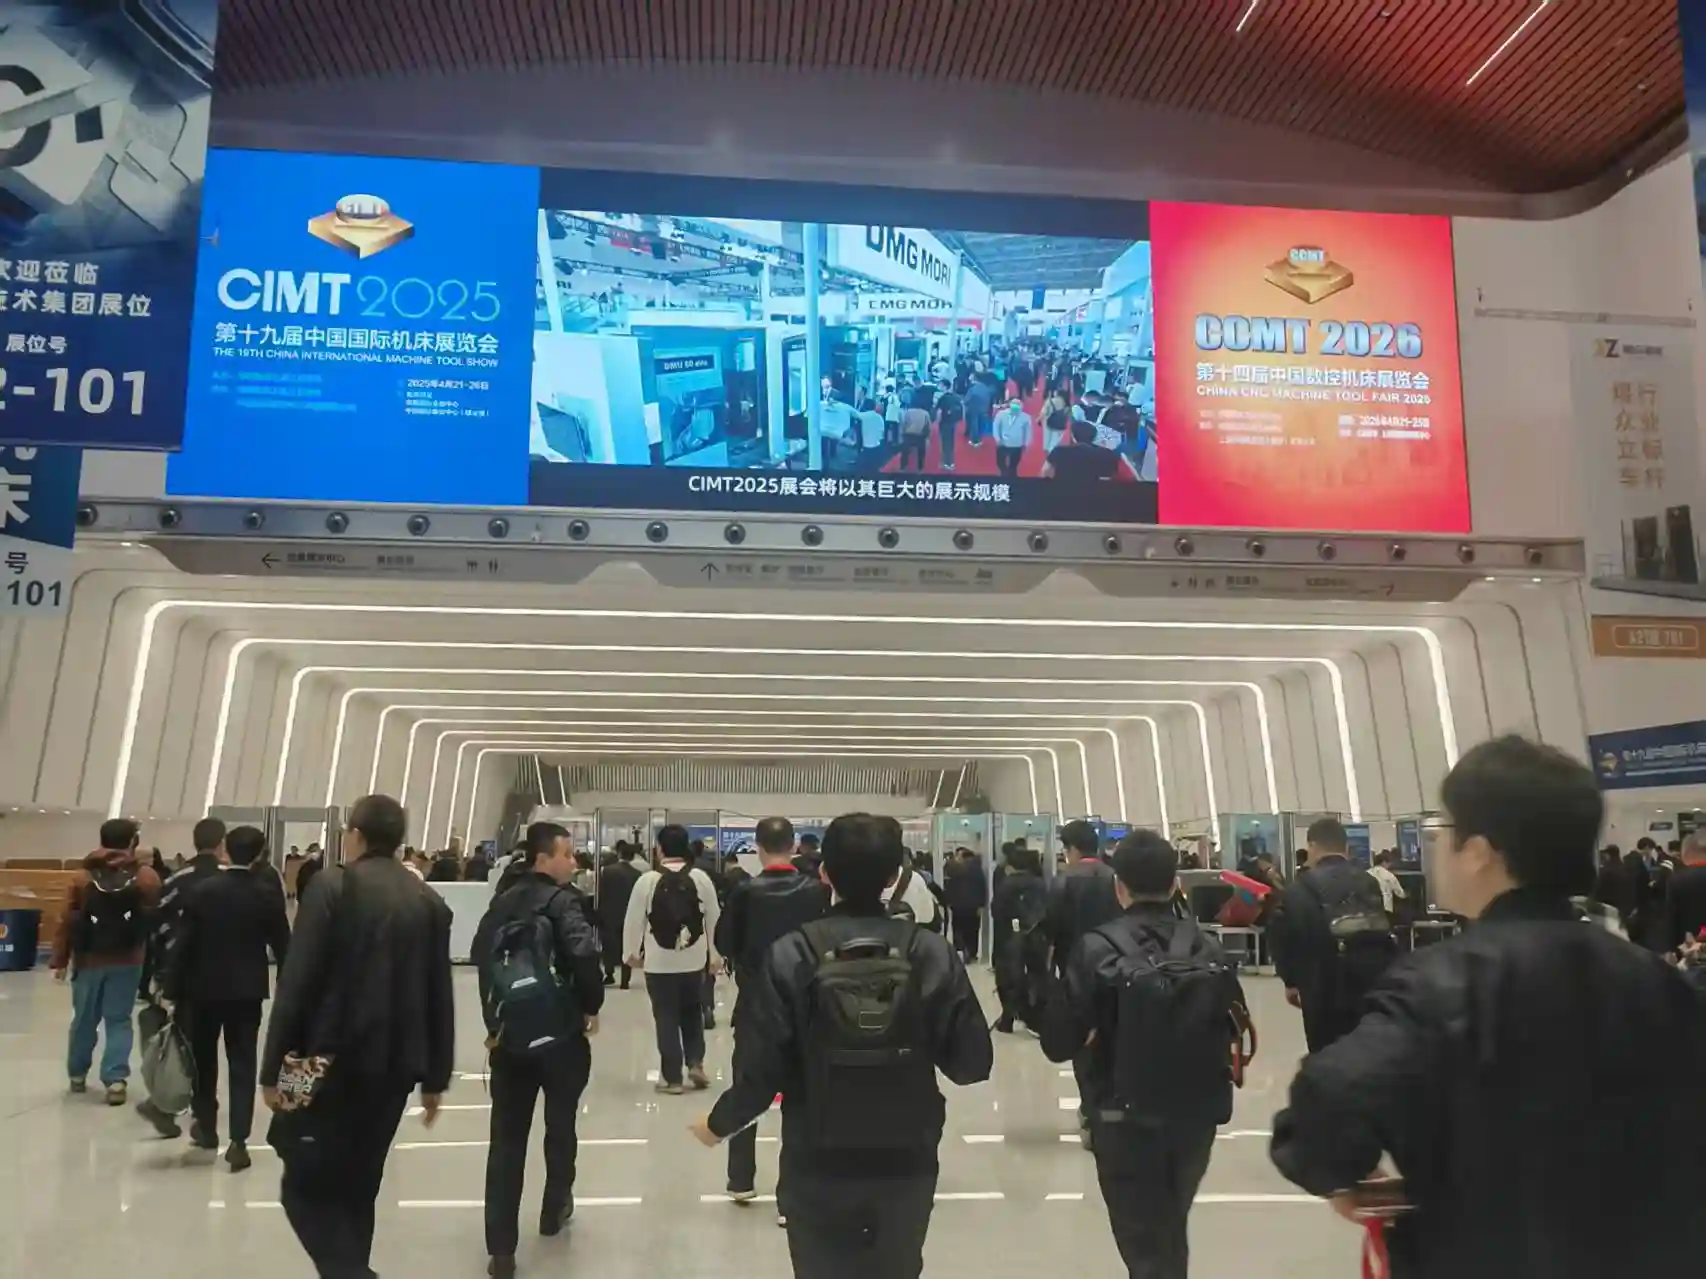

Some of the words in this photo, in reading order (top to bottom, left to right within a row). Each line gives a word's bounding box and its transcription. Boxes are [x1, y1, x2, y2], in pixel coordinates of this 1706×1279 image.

[920, 248, 952, 289] MORI
[0, 289, 152, 317] 术集团展位
[217, 268, 351, 316] CIMT
[356, 275, 502, 322] 2025
[6, 334, 67, 355] 展位号
[214, 321, 500, 355] 第十九届中国国际机床展览会
[1194, 313, 1311, 354] CCMT
[1318, 320, 1423, 358] 2026
[214, 347, 235, 358] THE
[238, 348, 264, 359] 19TH
[266, 349, 299, 360] CHINA
[302, 351, 383, 363] INTERNATIONAL
[386, 354, 433, 365] MACHINE
[437, 356, 464, 366] TOOL
[467, 357, 499, 368] SHOW
[1195, 361, 1430, 390] 第十四届中国数控机床展览会
[0, 366, 146, 417] -101
[1196, 384, 1240, 397] CHINA
[1241, 386, 1270, 398] CNC
[1272, 387, 1330, 400] MACHINE
[1335, 390, 1369, 402] TOOL
[1372, 393, 1400, 403] FAIR
[688, 475, 1011, 504] CIMT2025展会将以其巨大的展示规模
[5, 552, 29, 574] 号
